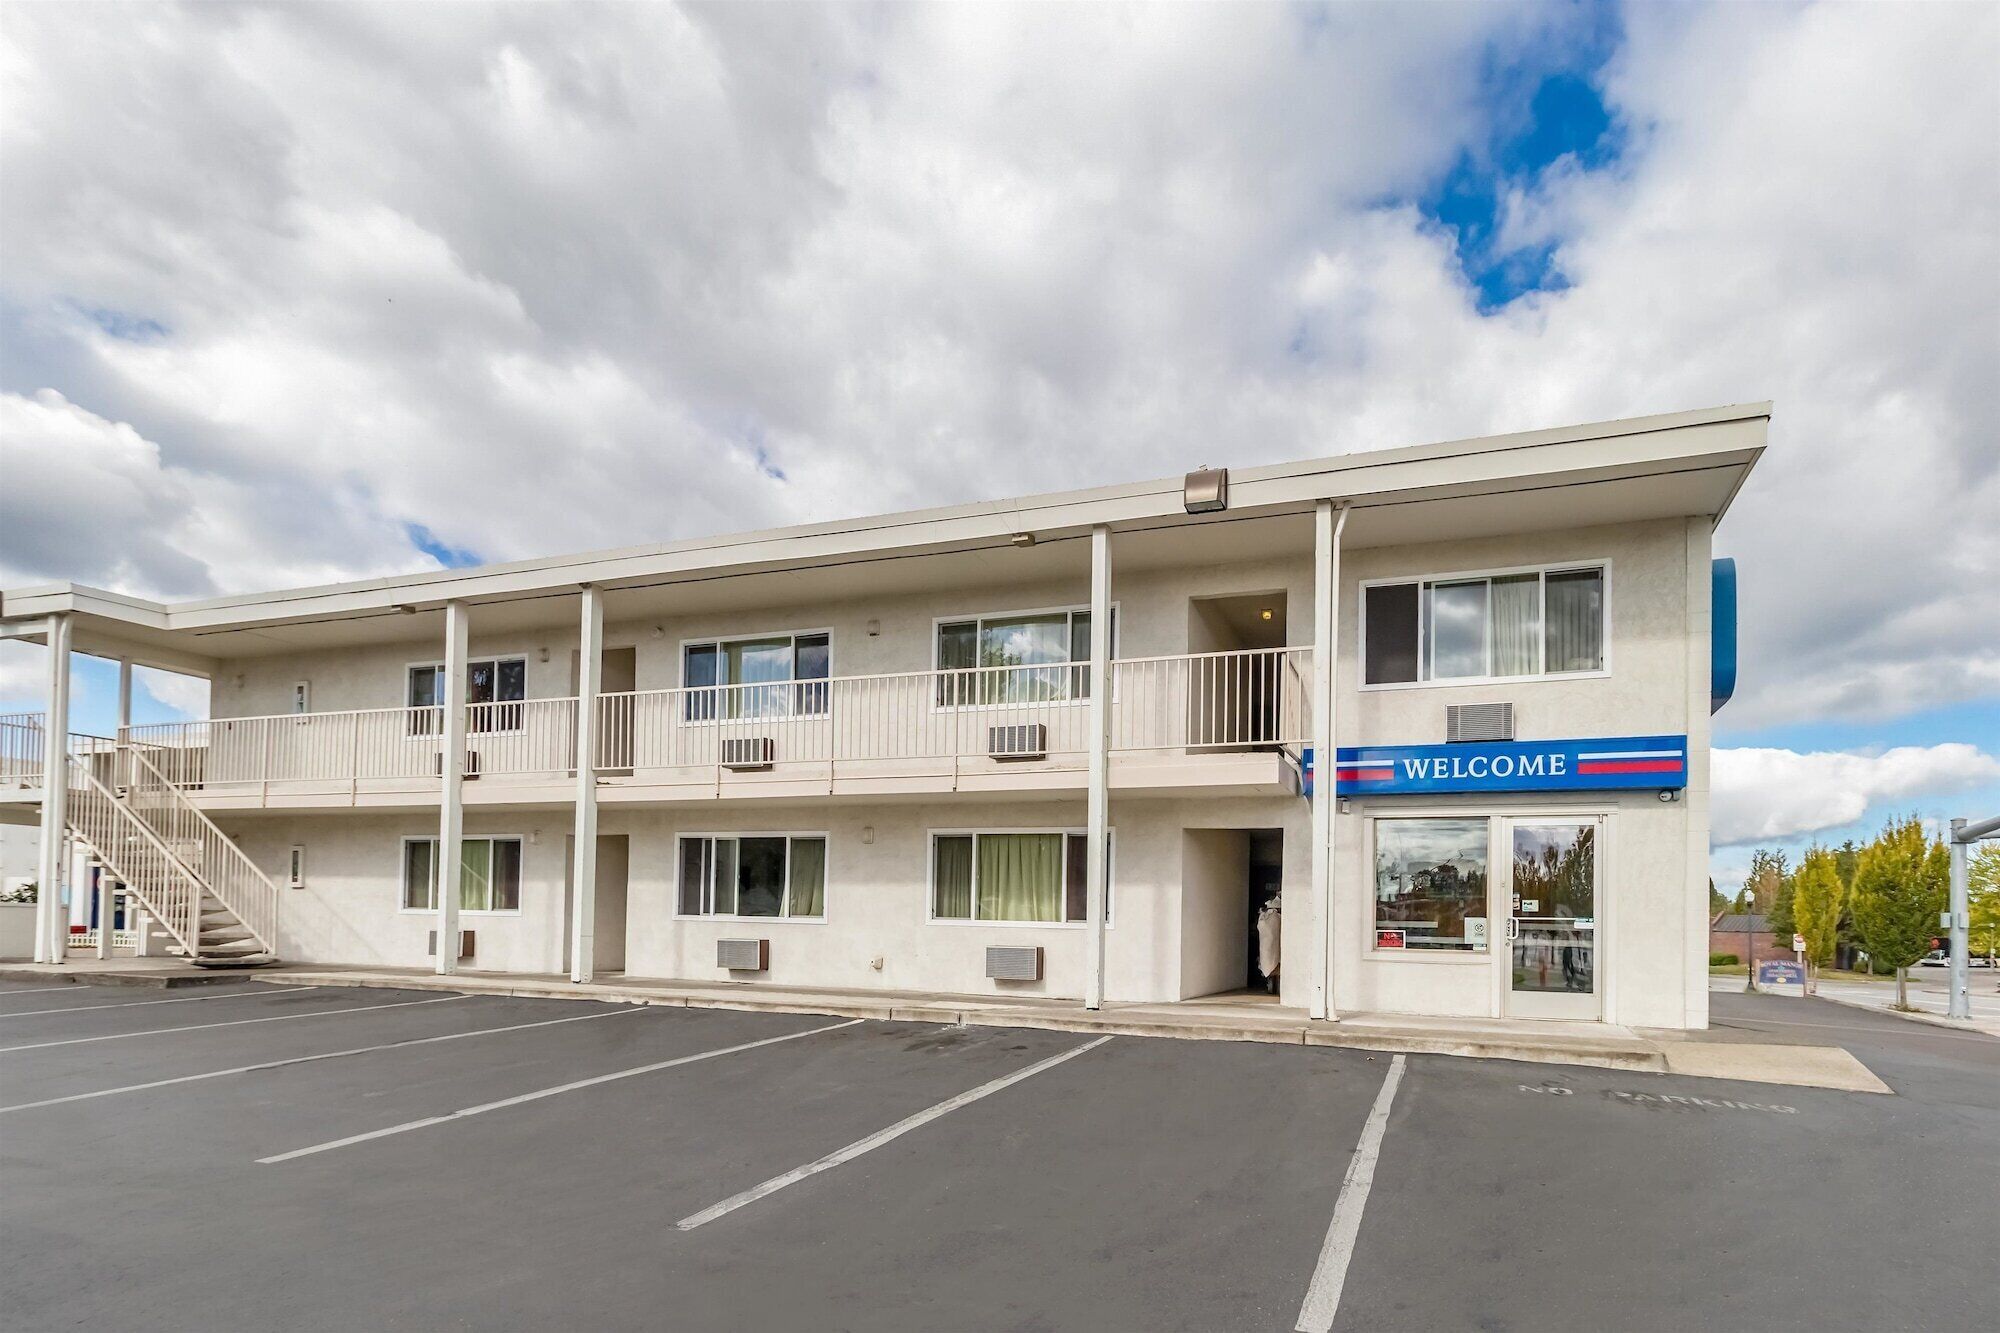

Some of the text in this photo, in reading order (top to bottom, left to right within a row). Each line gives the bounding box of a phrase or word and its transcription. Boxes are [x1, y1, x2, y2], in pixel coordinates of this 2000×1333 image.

[1403, 754, 1567, 779] WELCOME
[1518, 1084, 1799, 1114] NO PARKING
